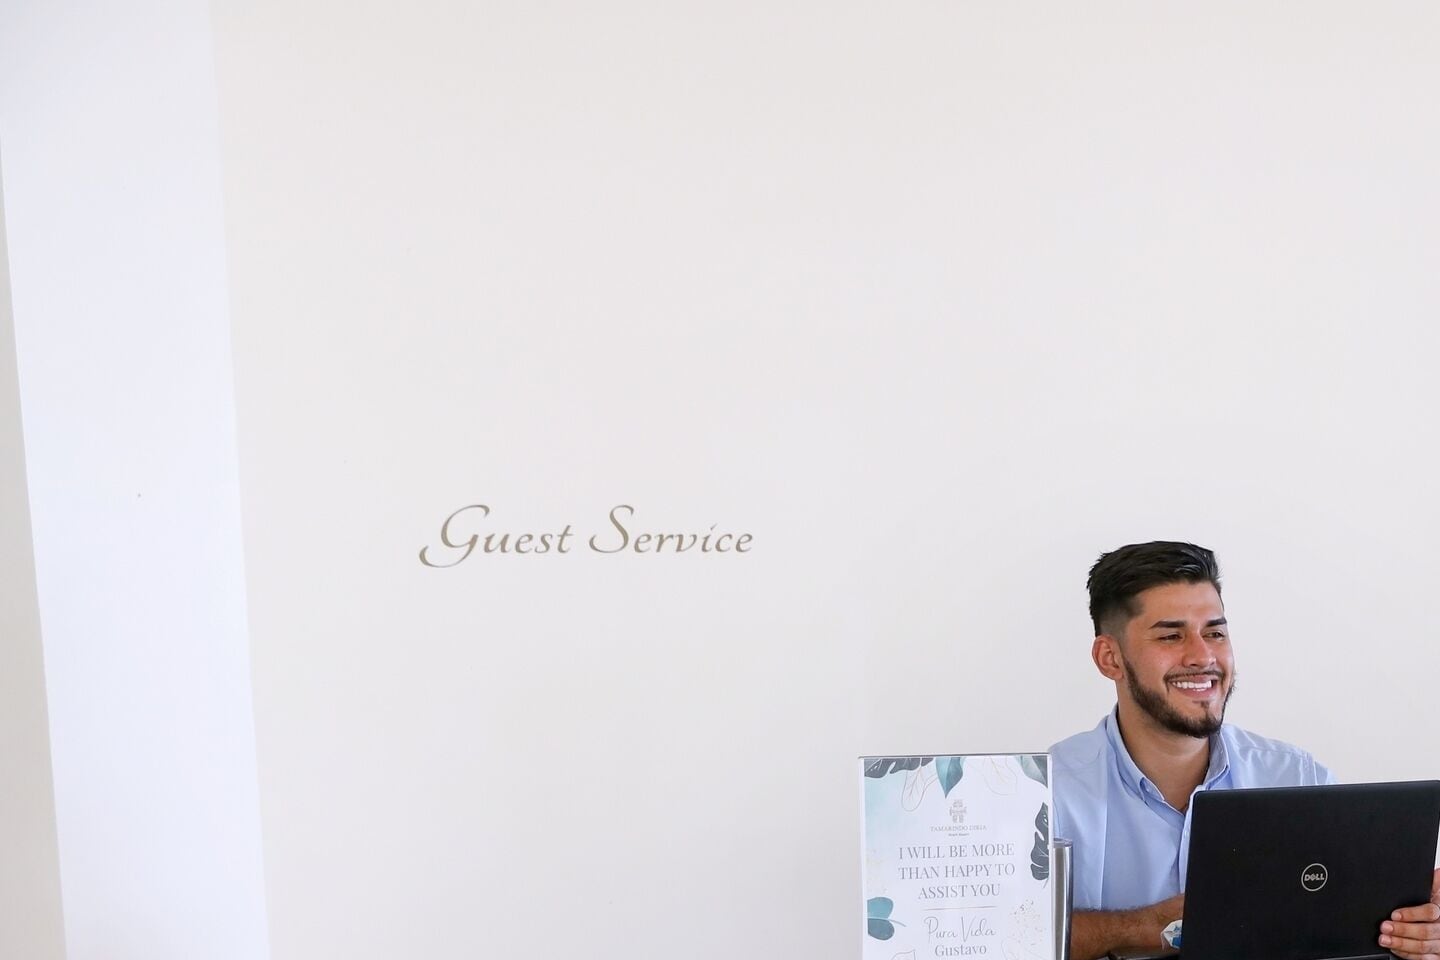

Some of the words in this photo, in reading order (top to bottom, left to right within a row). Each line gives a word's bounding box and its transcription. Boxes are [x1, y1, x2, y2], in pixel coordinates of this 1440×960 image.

[419, 504, 573, 568] Guest
[589, 504, 753, 553] Service
[899, 847, 903, 859] I
[907, 847, 947, 859] WILL
[949, 845, 968, 858] BE
[972, 843, 1015, 857] MORE
[898, 866, 940, 880] THAN
[944, 864, 993, 878] HAPPY
[995, 863, 1016, 876] TO
[1304, 873, 1325, 881] DELL
[918, 885, 969, 900] ASSIST
[970, 883, 1001, 897] YOU
[924, 916, 958, 944] Pura
[960, 916, 996, 943] Vida
[934, 943, 987, 957] Gustavo
